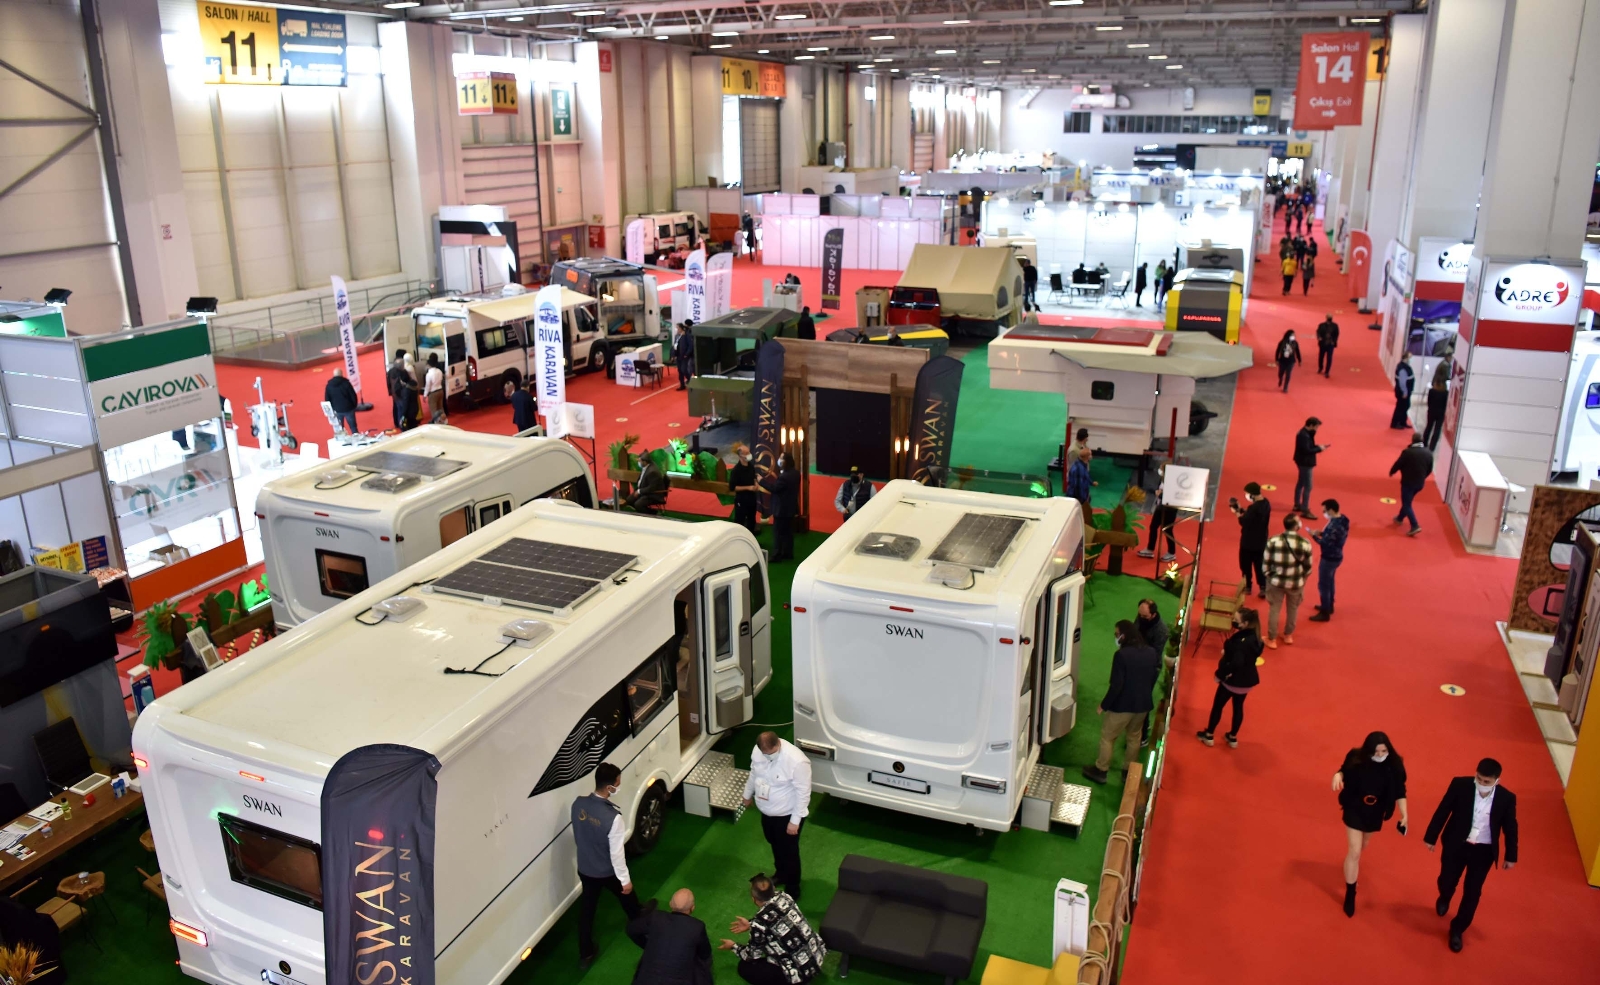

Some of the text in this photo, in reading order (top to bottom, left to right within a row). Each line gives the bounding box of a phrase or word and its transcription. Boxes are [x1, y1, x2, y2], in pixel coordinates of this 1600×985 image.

[205, 6, 238, 21] SALON
[248, 10, 271, 23] HALL
[221, 31, 257, 76] 11
[1311, 41, 1360, 53] Salon Hall
[1315, 55, 1354, 84] 14
[1372, 46, 1389, 73] 1
[722, 67, 730, 88] 11
[742, 69, 752, 90] 10
[461, 83, 477, 104] 11
[494, 83, 507, 104] 11
[1506, 290, 1554, 303] ADRE
[539, 325, 561, 343] RİVA
[545, 345, 558, 397] KARAVAN
[758, 379, 773, 440] SWAN
[920, 399, 942, 464] SWAN
[936, 401, 949, 465] KARAVAN
[315, 526, 340, 539] SWAN
[885, 624, 924, 639] SWAN
[243, 794, 282, 818] SWAN
[355, 841, 397, 985] SWAN
[400, 848, 412, 985] KARAVAN
